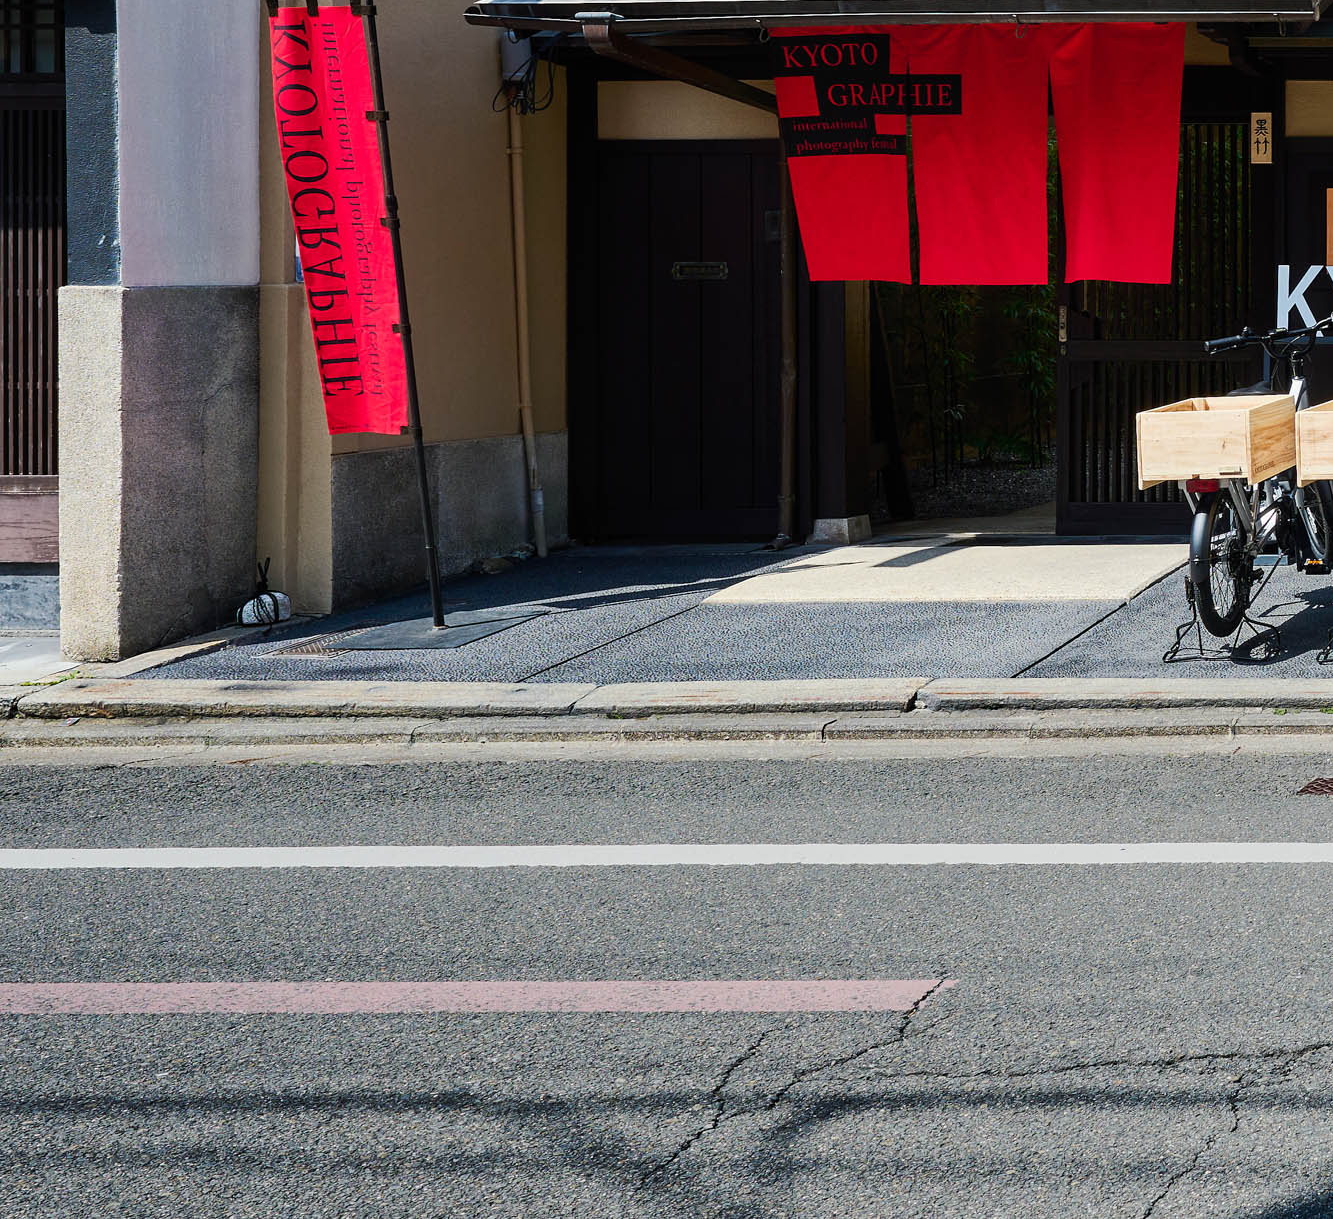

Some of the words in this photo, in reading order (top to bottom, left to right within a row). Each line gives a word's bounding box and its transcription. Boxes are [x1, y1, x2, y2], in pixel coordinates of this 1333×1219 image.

[781, 42, 879, 69] KYOTO
[827, 82, 953, 108] GRAPHIE
[792, 116, 869, 133] international
[796, 137, 869, 155] photography
